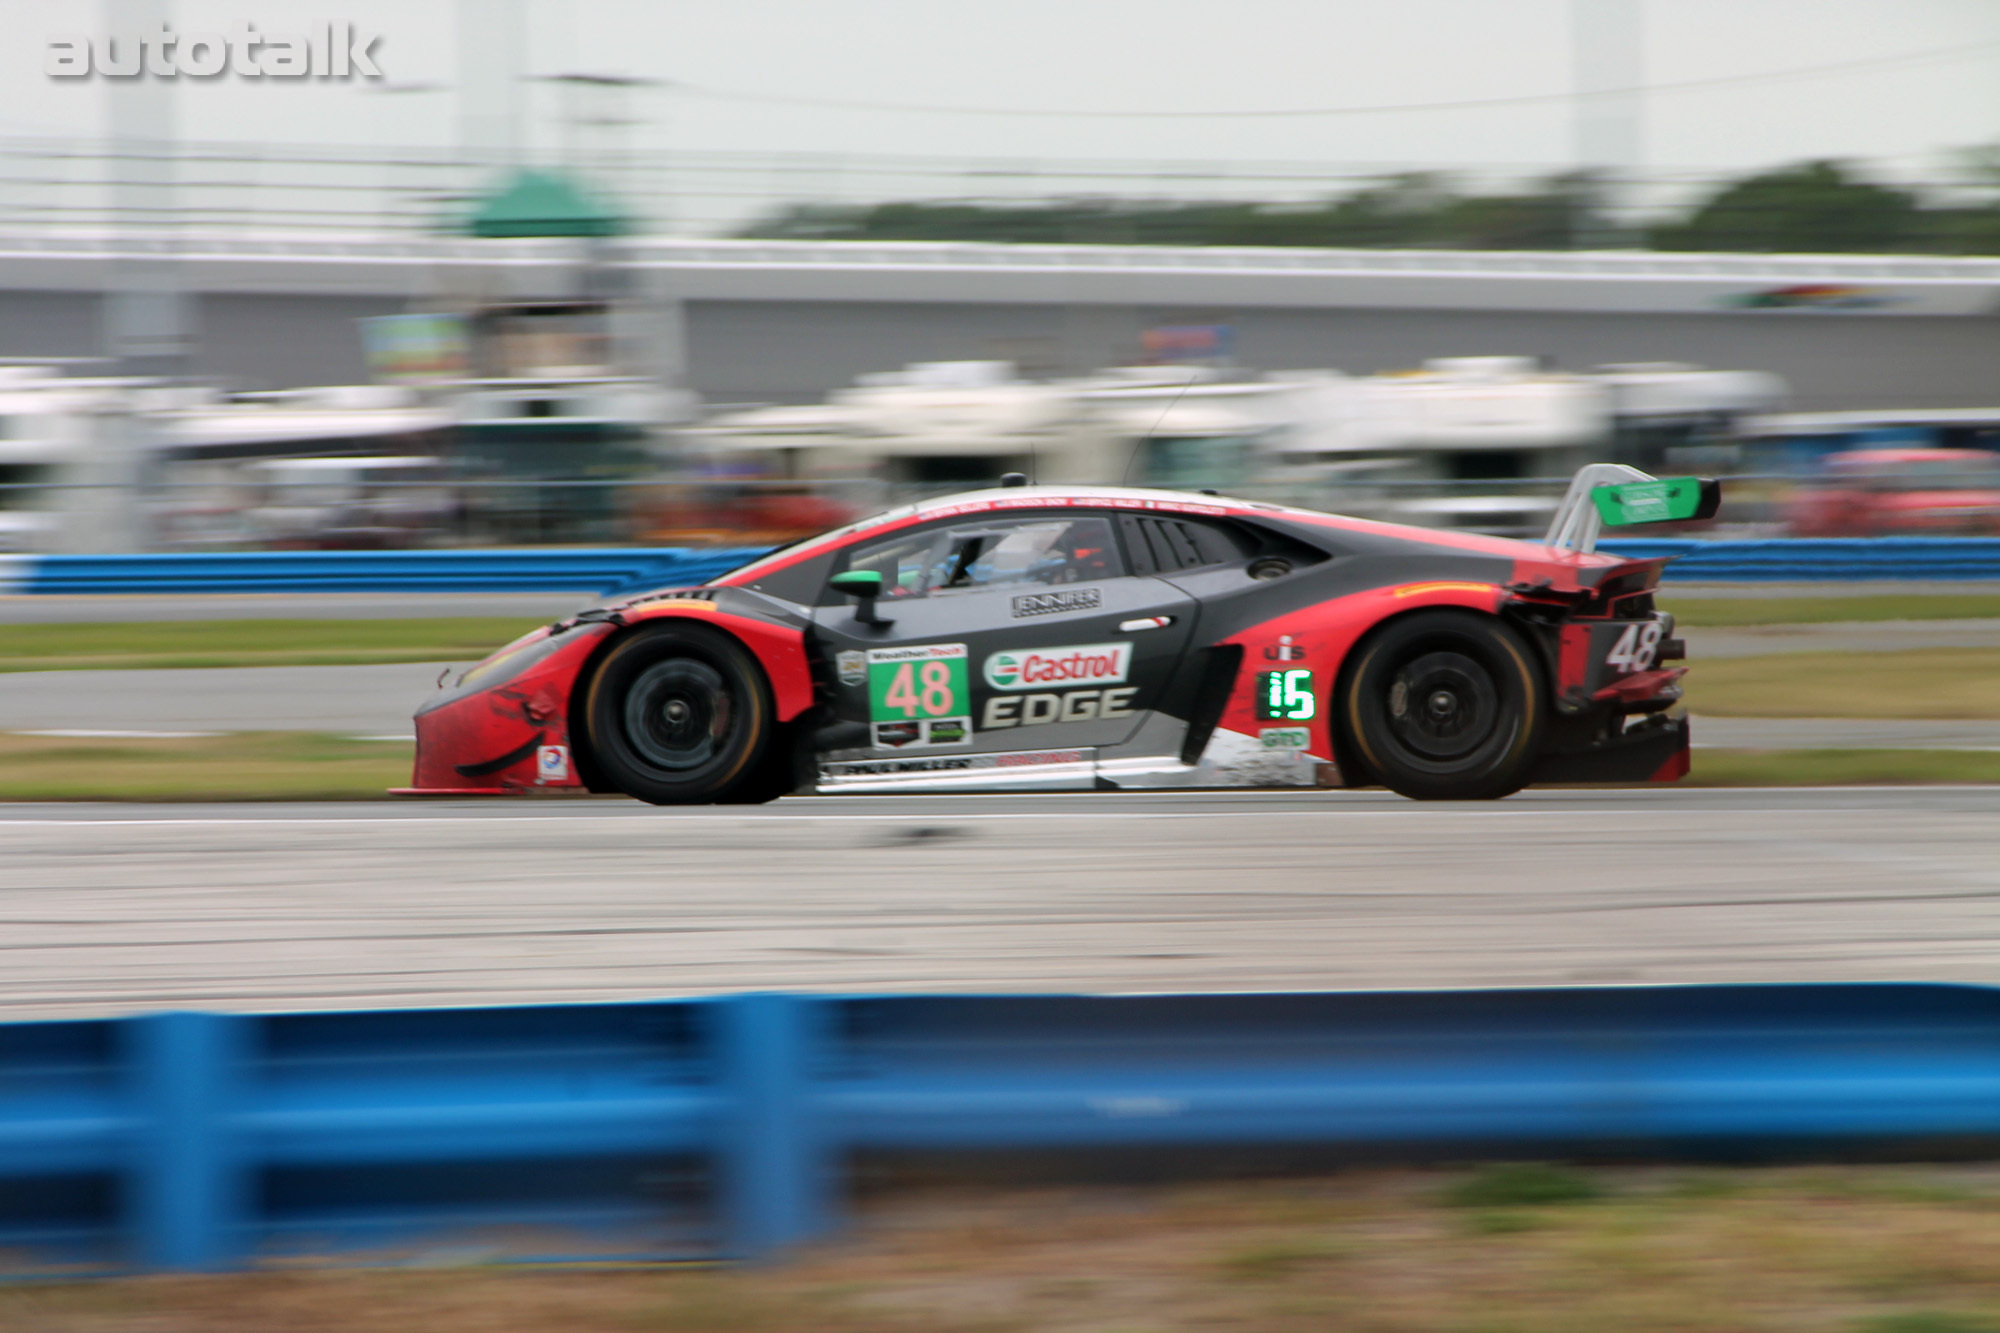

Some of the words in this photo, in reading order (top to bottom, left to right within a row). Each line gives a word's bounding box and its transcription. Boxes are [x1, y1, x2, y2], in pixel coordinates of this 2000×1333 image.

[1013, 589, 1099, 611] JENNIFER
[1023, 650, 1120, 683] Castrol
[1606, 622, 1663, 673] 48
[885, 661, 954, 717] 48
[982, 687, 1139, 729] EDGE
